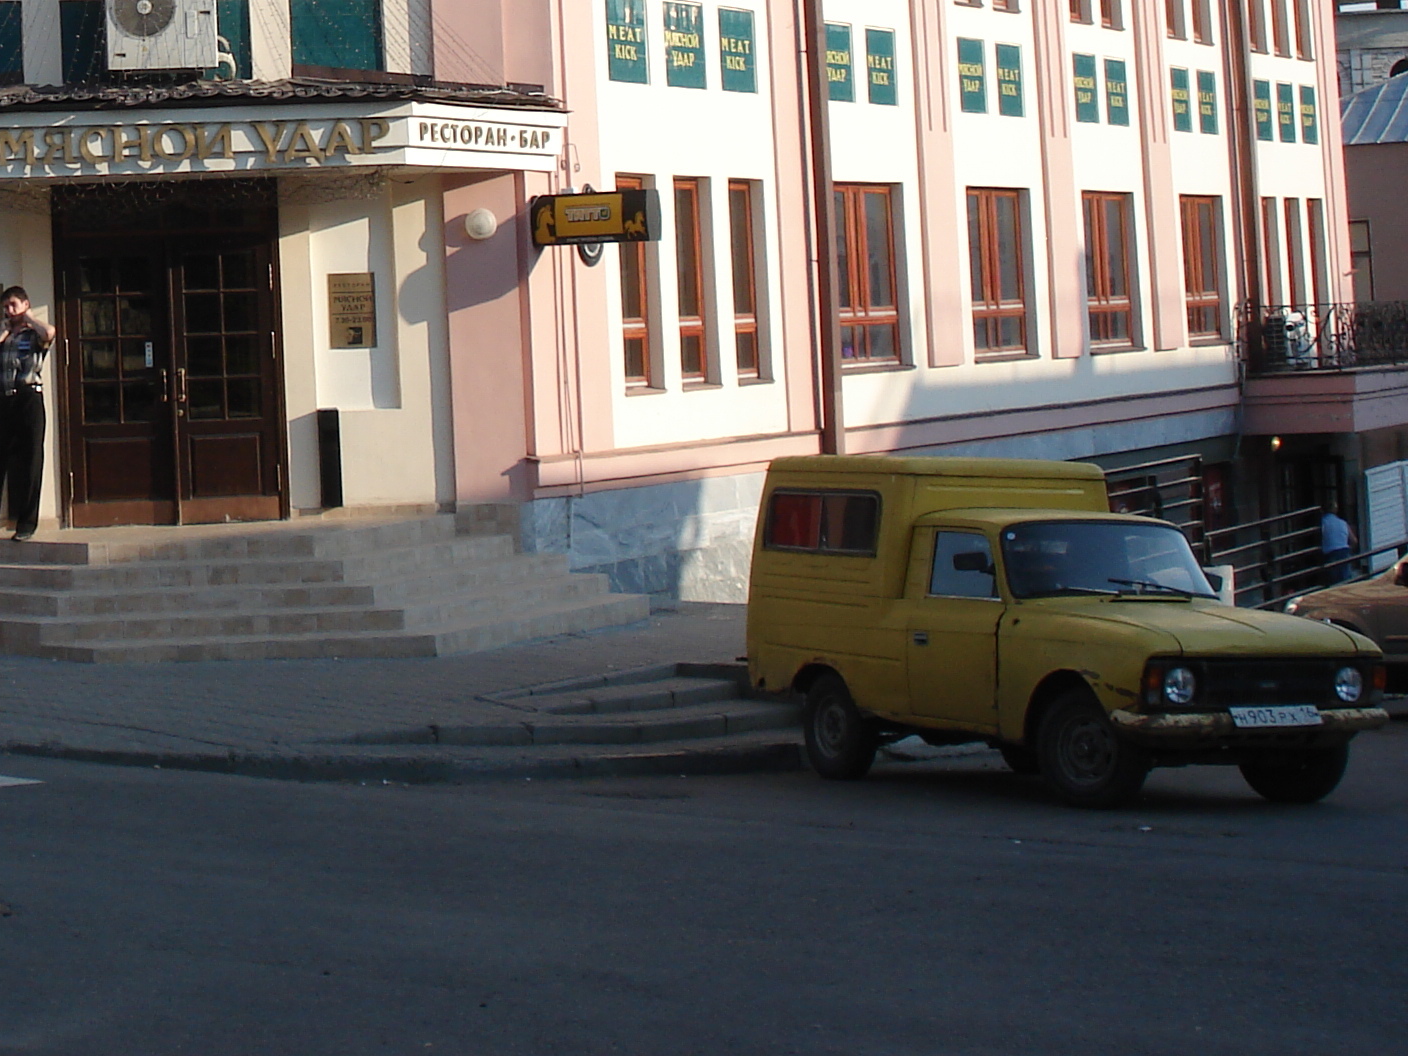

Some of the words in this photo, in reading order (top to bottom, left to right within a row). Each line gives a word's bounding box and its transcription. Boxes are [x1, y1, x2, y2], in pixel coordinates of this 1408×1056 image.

[608, 24, 642, 42] MEAT
[615, 44, 638, 61] KICK
[721, 37, 750, 54] MEAT
[671, 50, 695, 67] УДАР
[725, 55, 746, 71] KICK
[867, 55, 892, 70] MEAT
[871, 72, 890, 85] KICK
[250, 118, 390, 165] УДАР
[418, 121, 508, 148] РЕСТОРАН
[518, 130, 551, 150] БАР
